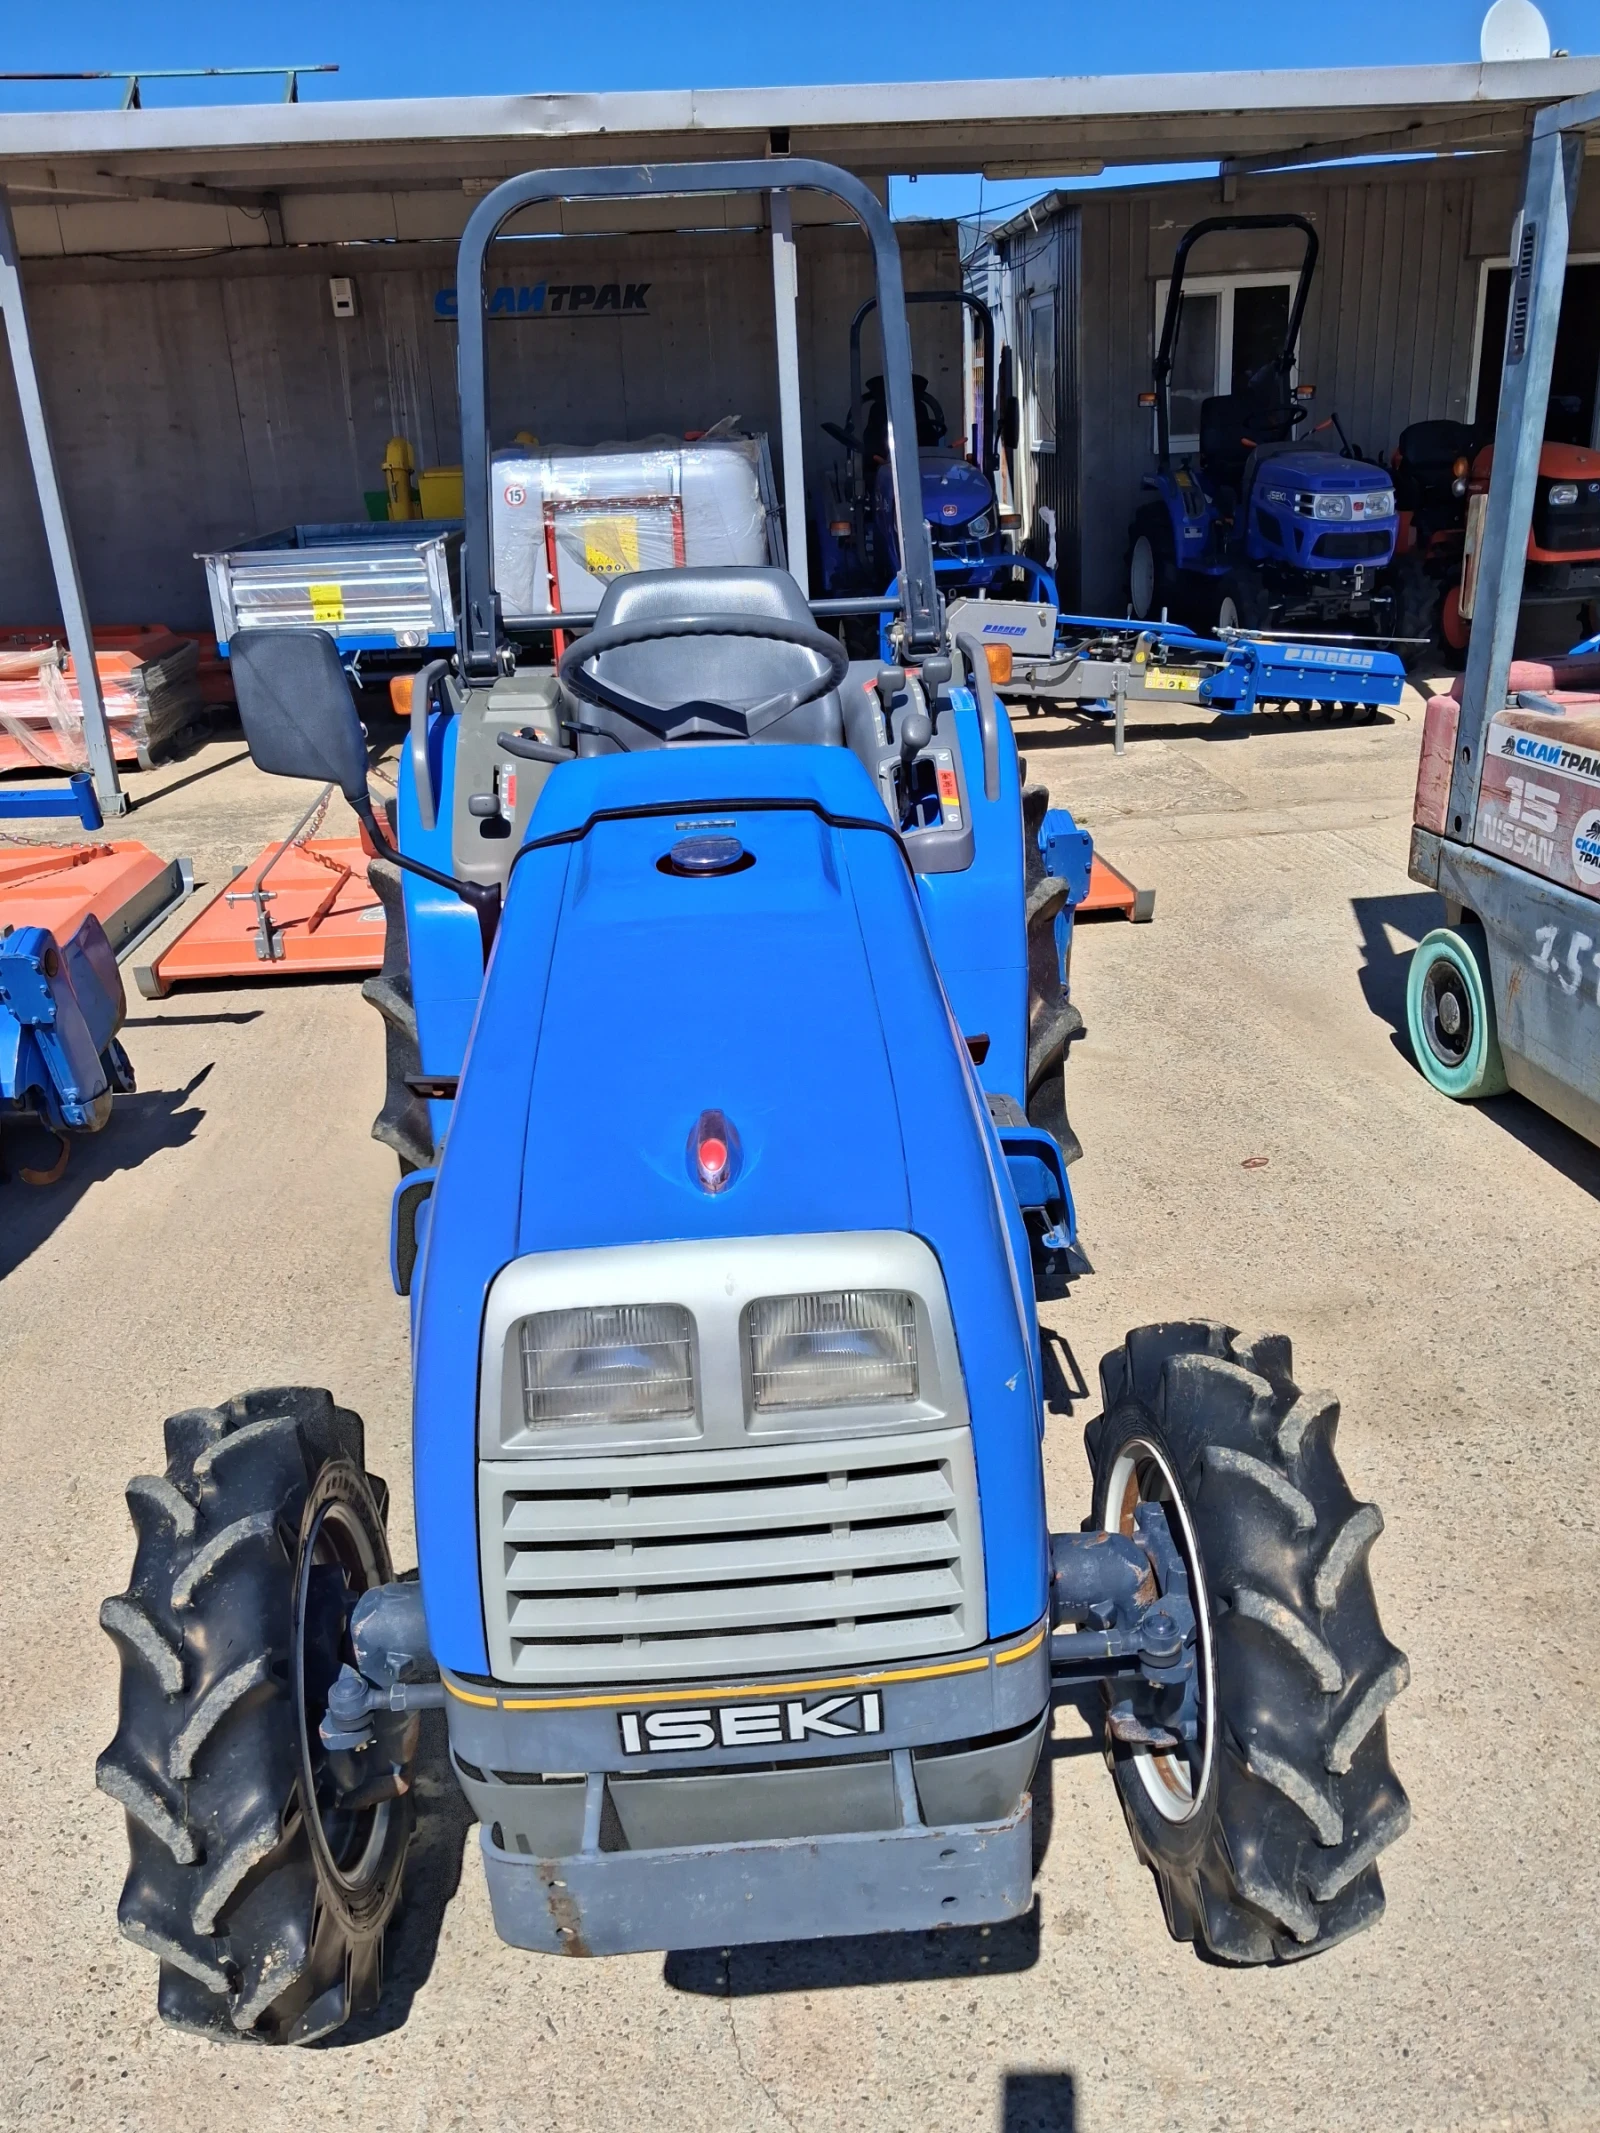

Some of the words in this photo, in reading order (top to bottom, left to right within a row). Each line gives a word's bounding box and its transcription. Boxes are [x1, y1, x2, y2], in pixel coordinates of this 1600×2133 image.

[434, 280, 651, 315] САЙТРАК
[509, 489, 521, 502] 15
[1505, 776, 1560, 833] 15
[1482, 814, 1554, 867] NISSAN
[1579, 851, 1600, 868] ТРА
[618, 1690, 882, 1755] ISEKI
